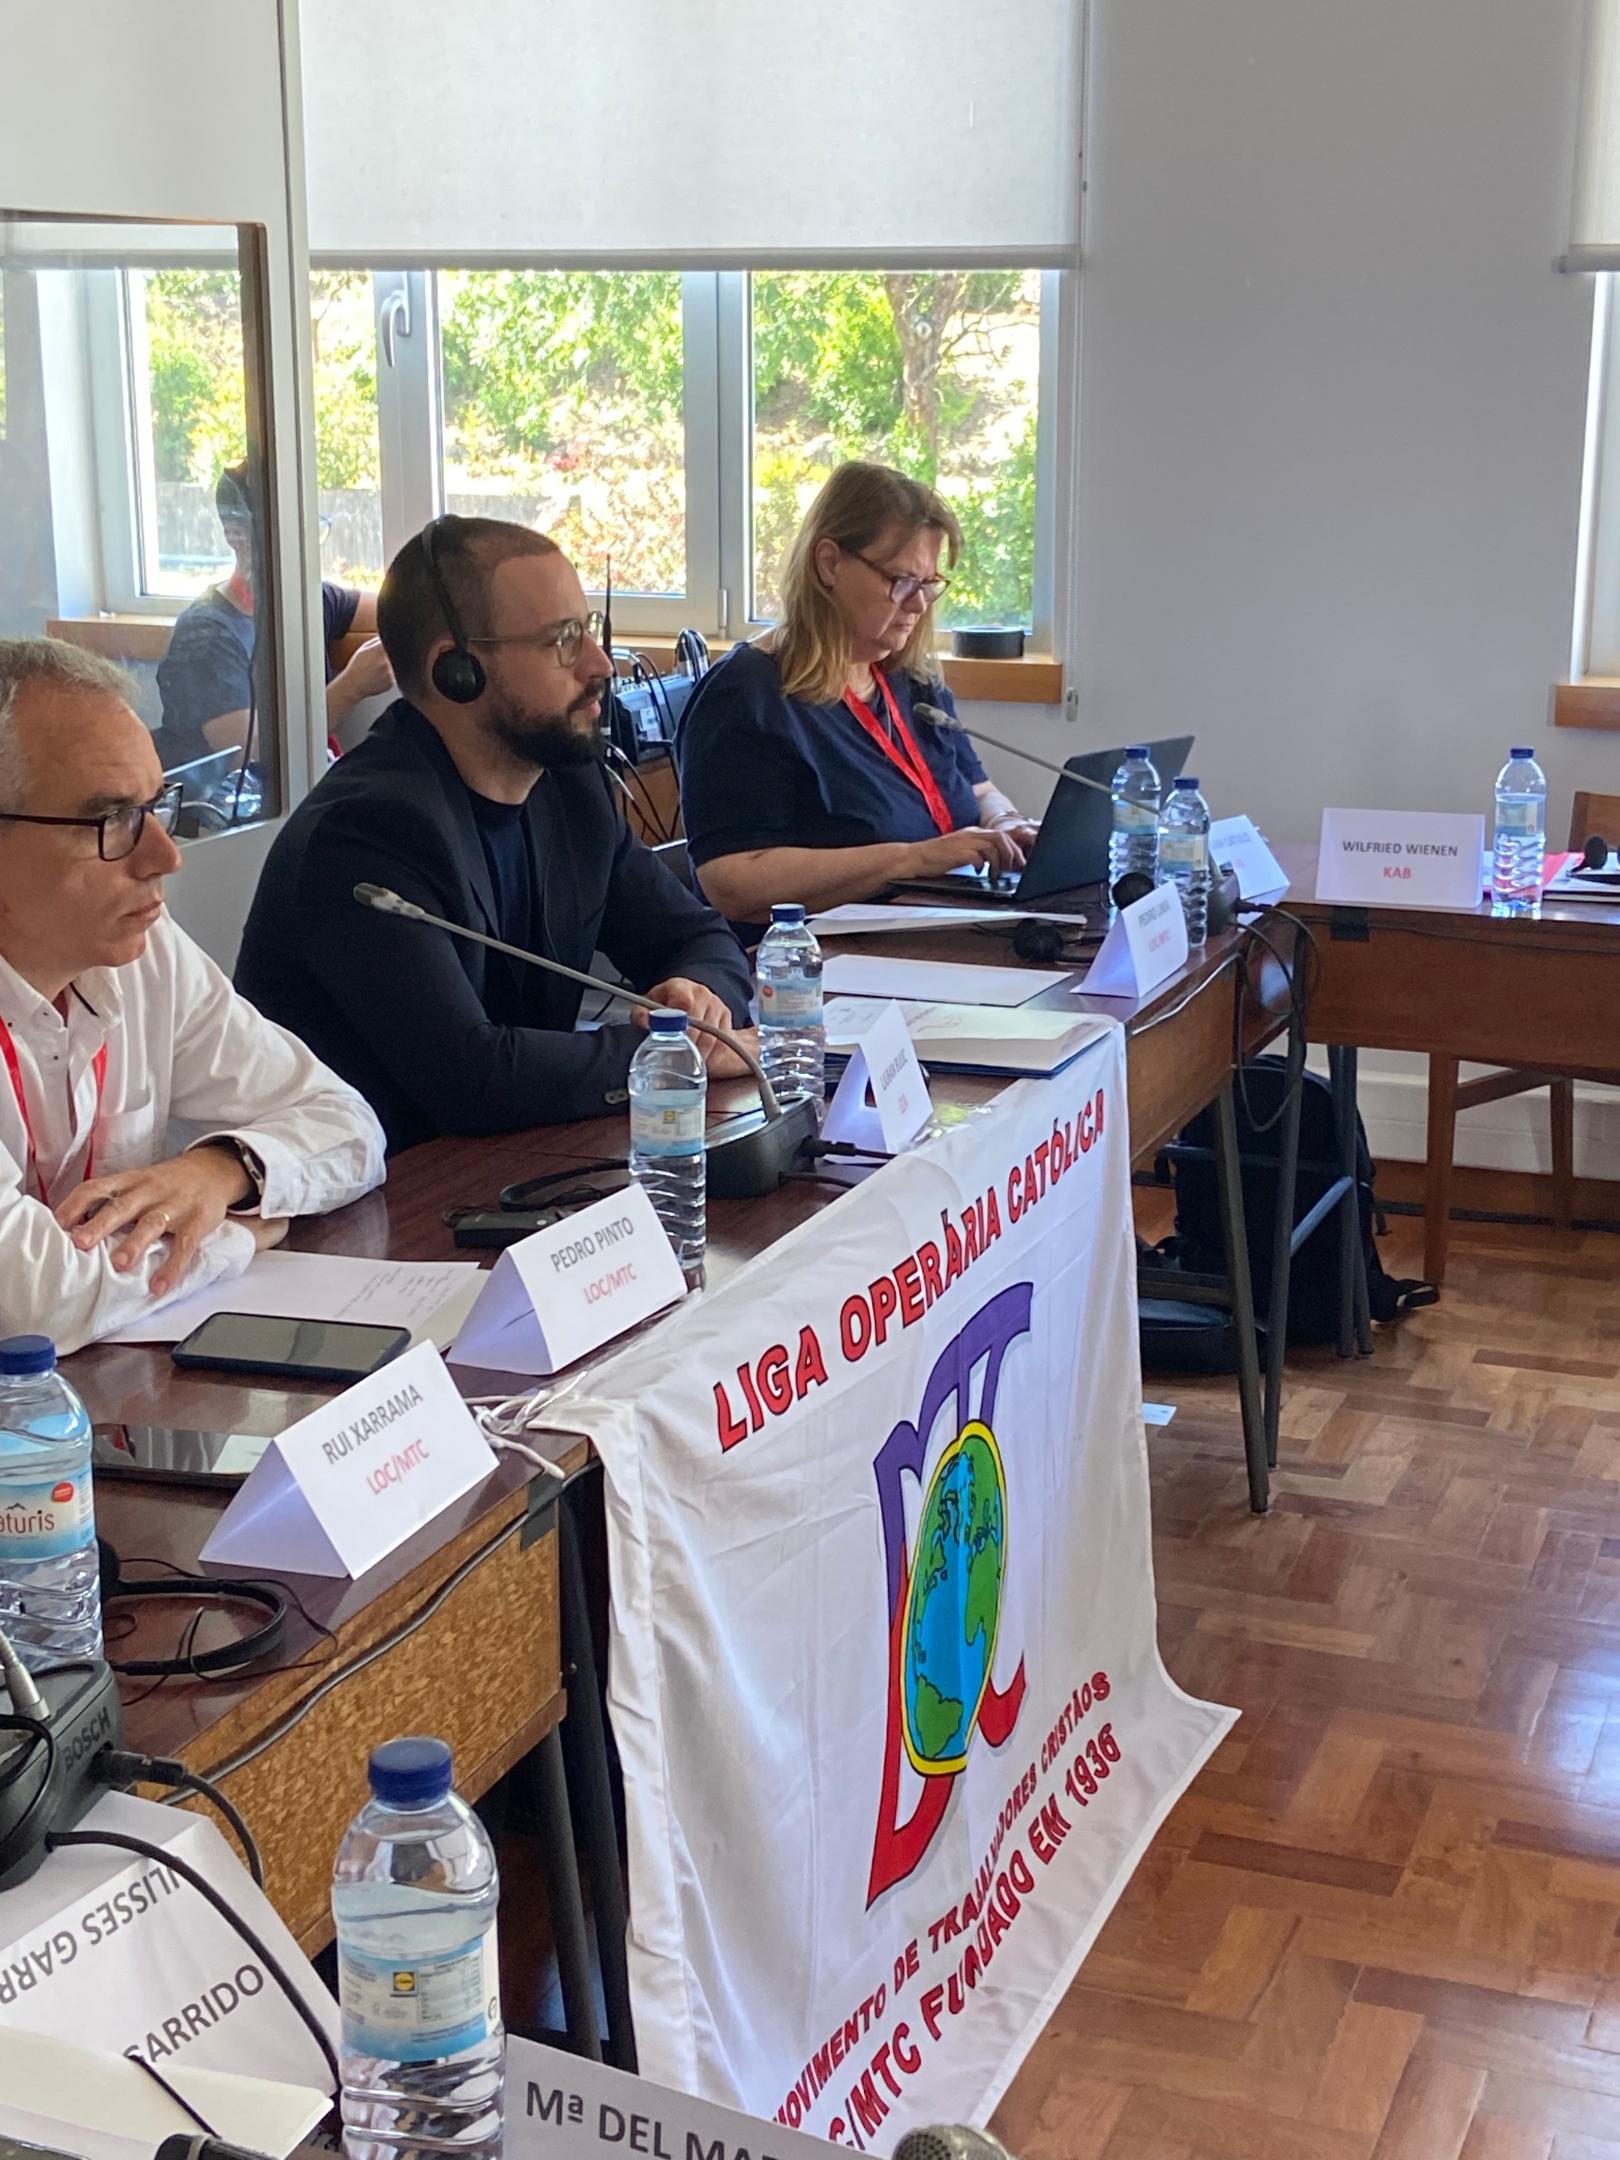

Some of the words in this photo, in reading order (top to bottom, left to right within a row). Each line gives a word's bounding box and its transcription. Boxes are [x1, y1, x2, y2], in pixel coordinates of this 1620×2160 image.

[1342, 840, 1401, 854] WILFRIED
[1406, 843, 1458, 856] WIENEN
[1383, 866, 1412, 879] KAB
[551, 1236, 595, 1272] PEDRO
[595, 1217, 634, 1249] PINTO
[713, 1325, 829, 1453] LIGA
[840, 1186, 1002, 1363] OPERÁRIA
[1007, 1088, 1104, 1223] CATÓLICA
[584, 1263, 637, 1304] LOC/MTC
[322, 1431, 354, 1464] RUI
[349, 1384, 424, 1446] XARRAMA
[366, 1438, 430, 1495] LOC/MTC
[62, 1706, 110, 1773] BOSCH
[82, 1867, 180, 1945] LISSES
[894, 1938, 920, 1995] DE
[928, 1763, 1037, 1953] TRAALDORES
[920, 1850, 1035, 2041] FUNDADO
[1028, 1792, 1072, 1865] EM
[1065, 1723, 1121, 1806] 1936
[526, 2081, 583, 2125] Mª
[599, 2104, 671, 2160] DEL
